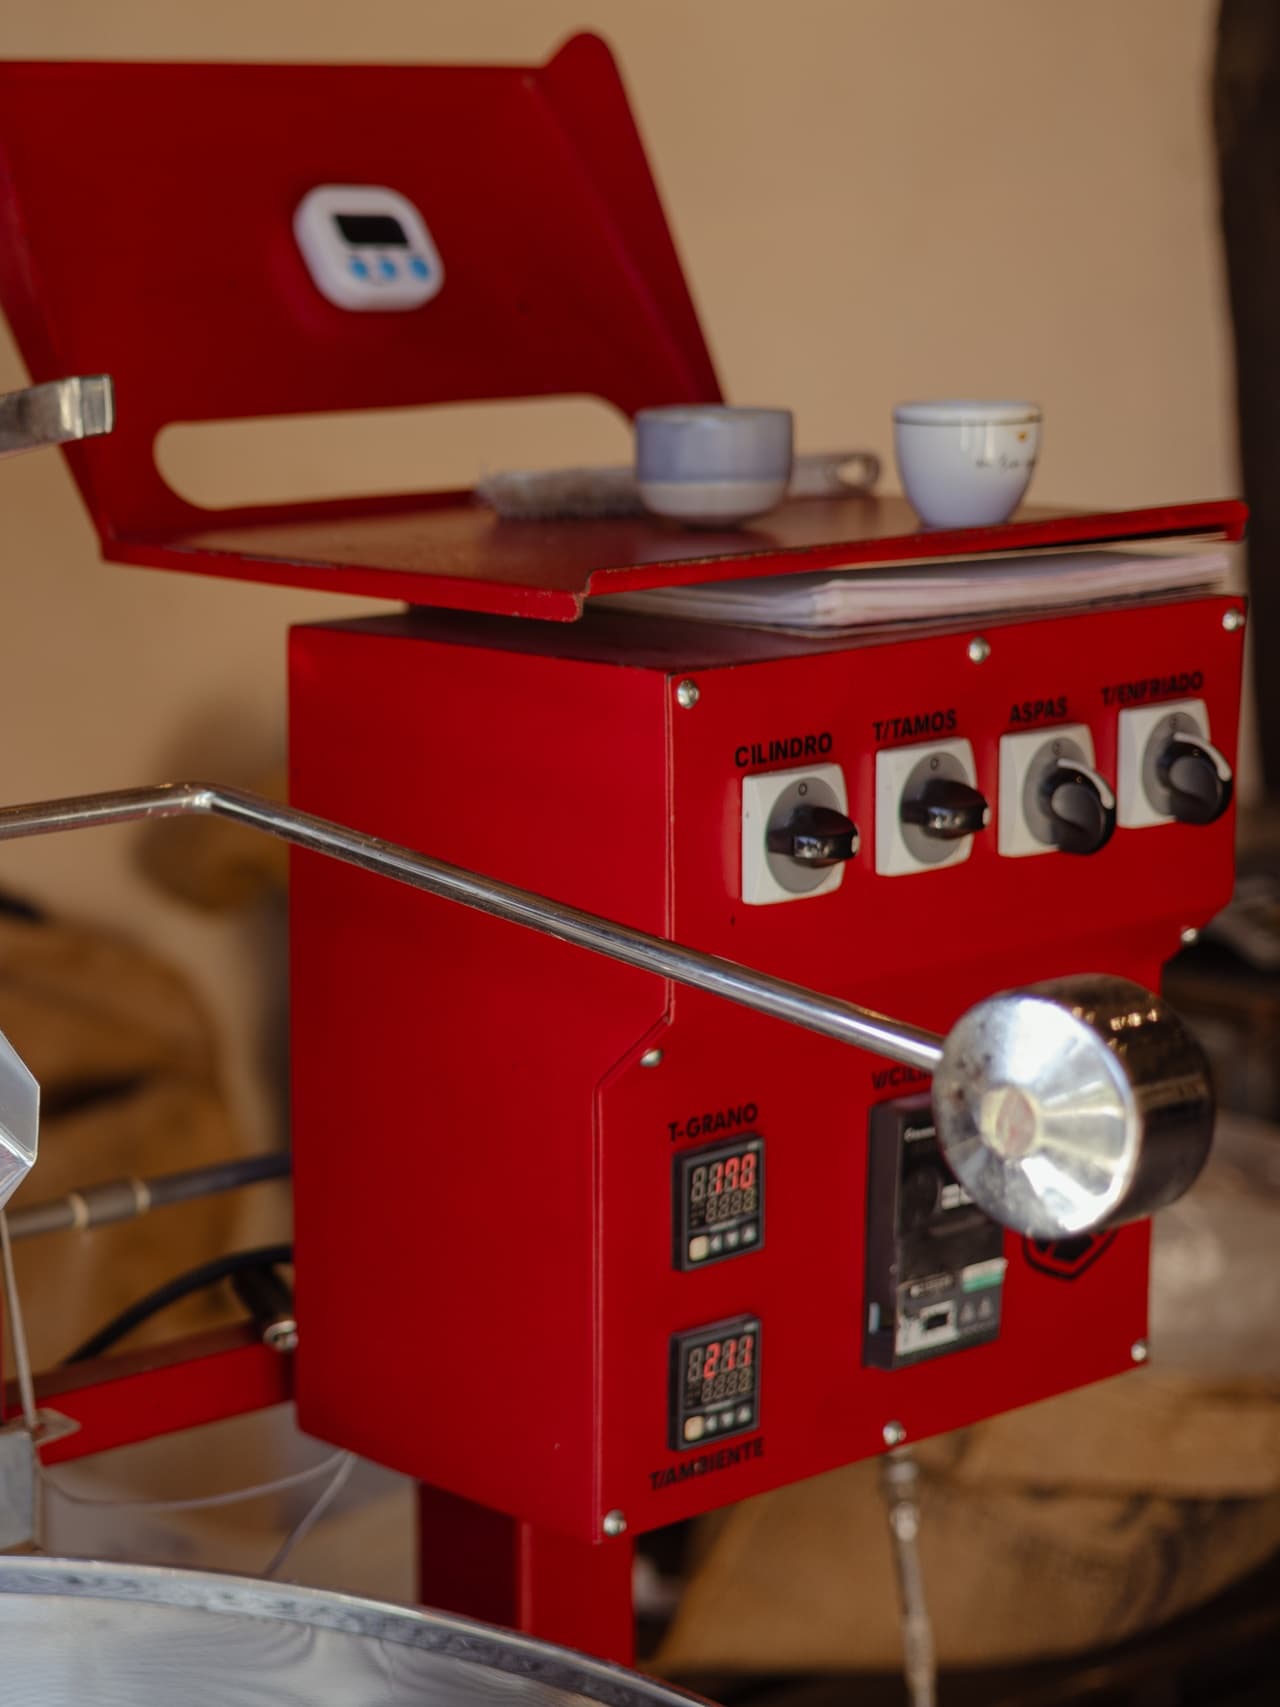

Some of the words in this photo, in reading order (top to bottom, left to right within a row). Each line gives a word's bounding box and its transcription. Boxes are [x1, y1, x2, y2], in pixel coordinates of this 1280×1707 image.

[1100, 671, 1205, 706] T/ENFRIADO
[872, 709, 958, 742] T/TAMOS
[1009, 697, 1068, 724] ASPAS
[734, 732, 833, 768] CILINDRO
[667, 1103, 759, 1142] T-GRANO
[648, 1437, 765, 1491] T/AMBIENTE
